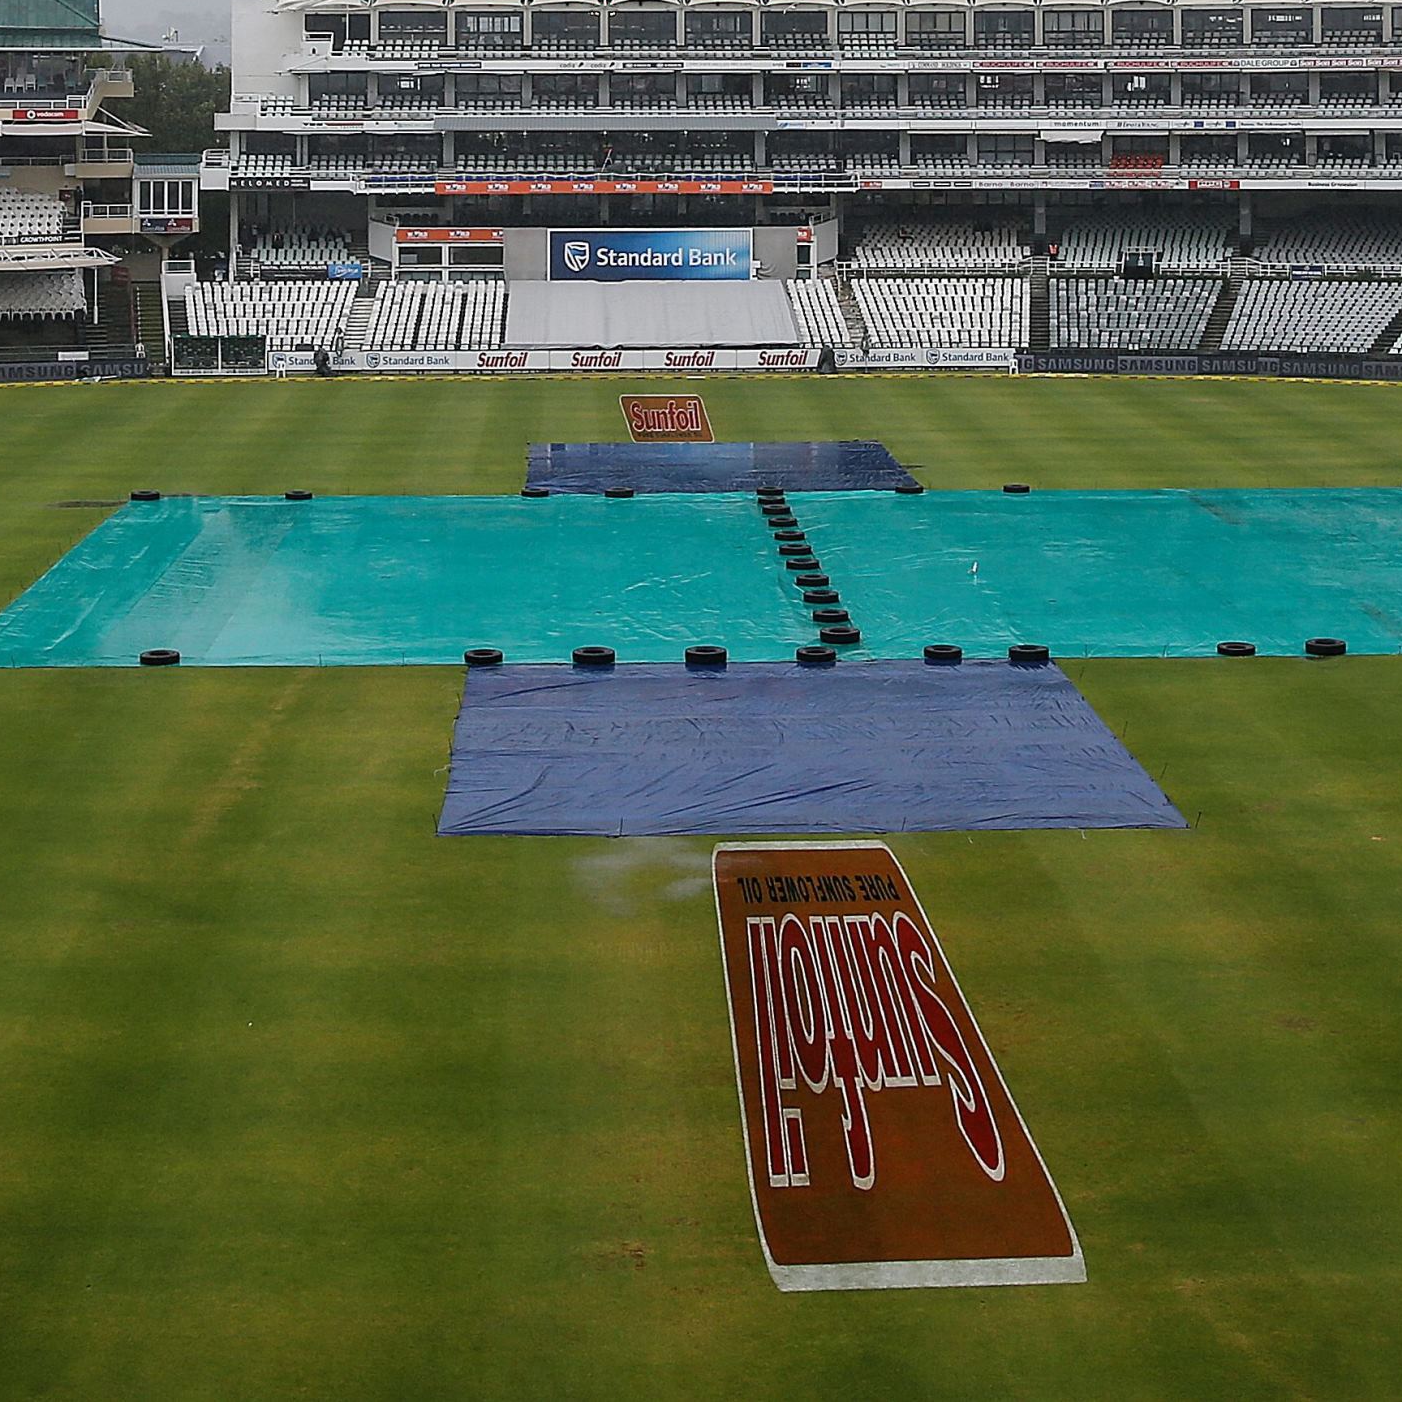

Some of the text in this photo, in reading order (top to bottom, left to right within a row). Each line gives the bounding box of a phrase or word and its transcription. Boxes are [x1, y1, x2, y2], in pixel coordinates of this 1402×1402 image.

[596, 247, 737, 267] Standard Bank
[333, 356, 356, 365] Bank
[383, 356, 450, 365] Standard Bank
[477, 352, 528, 367] Sunfoil
[571, 352, 622, 367] Sunfoil
[664, 351, 715, 366] Sunfoil
[758, 351, 808, 366] Sunfoil
[849, 353, 916, 363] Standard Bank
[942, 353, 1009, 362] Standard Bank
[1038, 358, 1115, 371] SAMSUNG
[81, 362, 143, 376] SAMSU
[1119, 359, 1196, 372] SAMSUNG
[1202, 359, 1279, 372] SAMSUNG
[1282, 361, 1360, 376] SAMSUNG
[630, 400, 701, 432] Sunfoil
[737, 874, 901, 904] PURE SUNFLOWER OIL
[746, 911, 1006, 1190] Sunfoil
